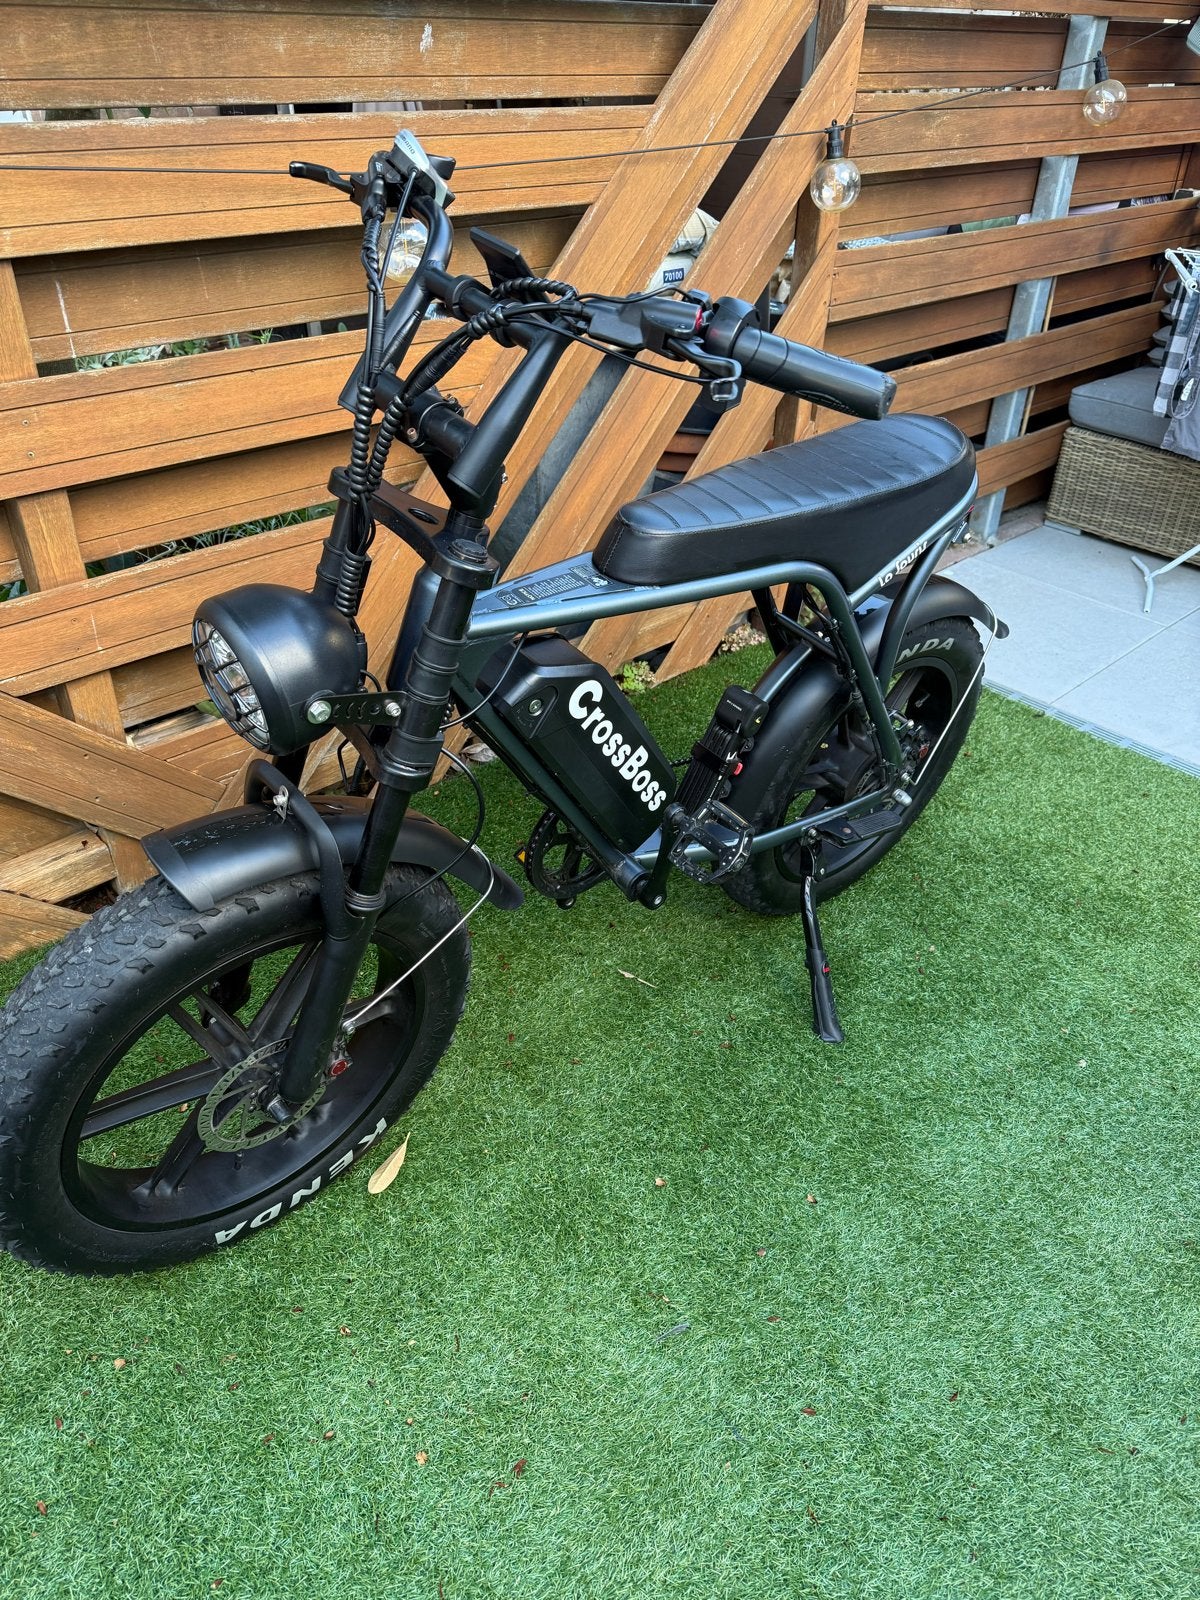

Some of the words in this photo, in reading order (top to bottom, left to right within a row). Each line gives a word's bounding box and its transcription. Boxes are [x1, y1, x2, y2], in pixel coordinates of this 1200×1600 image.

[664, 271, 682, 281] 70100
[895, 637, 955, 664] NDA
[568, 680, 666, 812] CrossBoss
[215, 1117, 387, 1244] KENDA
